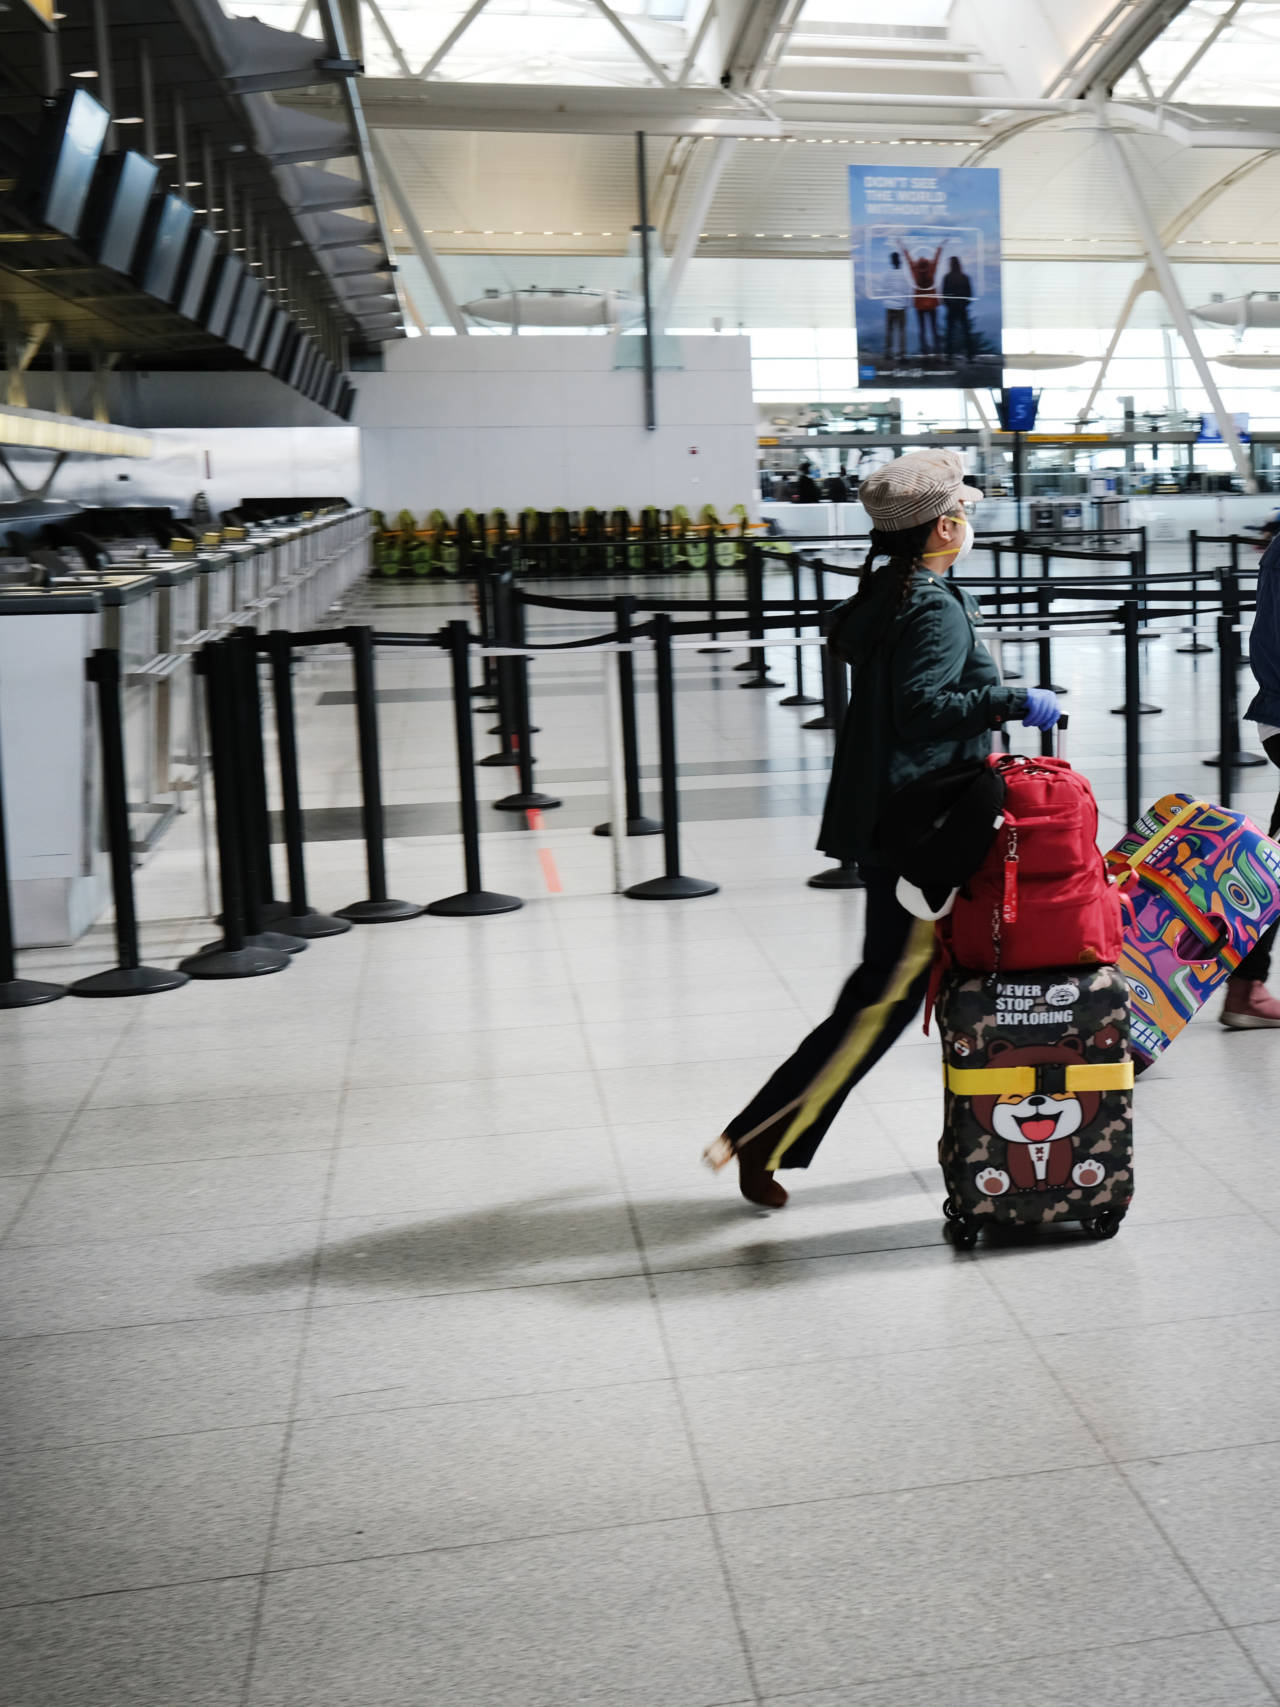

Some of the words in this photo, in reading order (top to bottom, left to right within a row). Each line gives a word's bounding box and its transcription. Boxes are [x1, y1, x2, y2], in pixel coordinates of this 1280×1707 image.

[911, 177, 938, 189] SEE
[864, 190, 894, 201] THE
[896, 191, 947, 202] WORLD
[864, 203, 929, 215] WITHOUT
[996, 983, 1041, 996] NEVER
[996, 997, 1034, 1010] STOP
[996, 1010, 1073, 1025] EXPLORING
